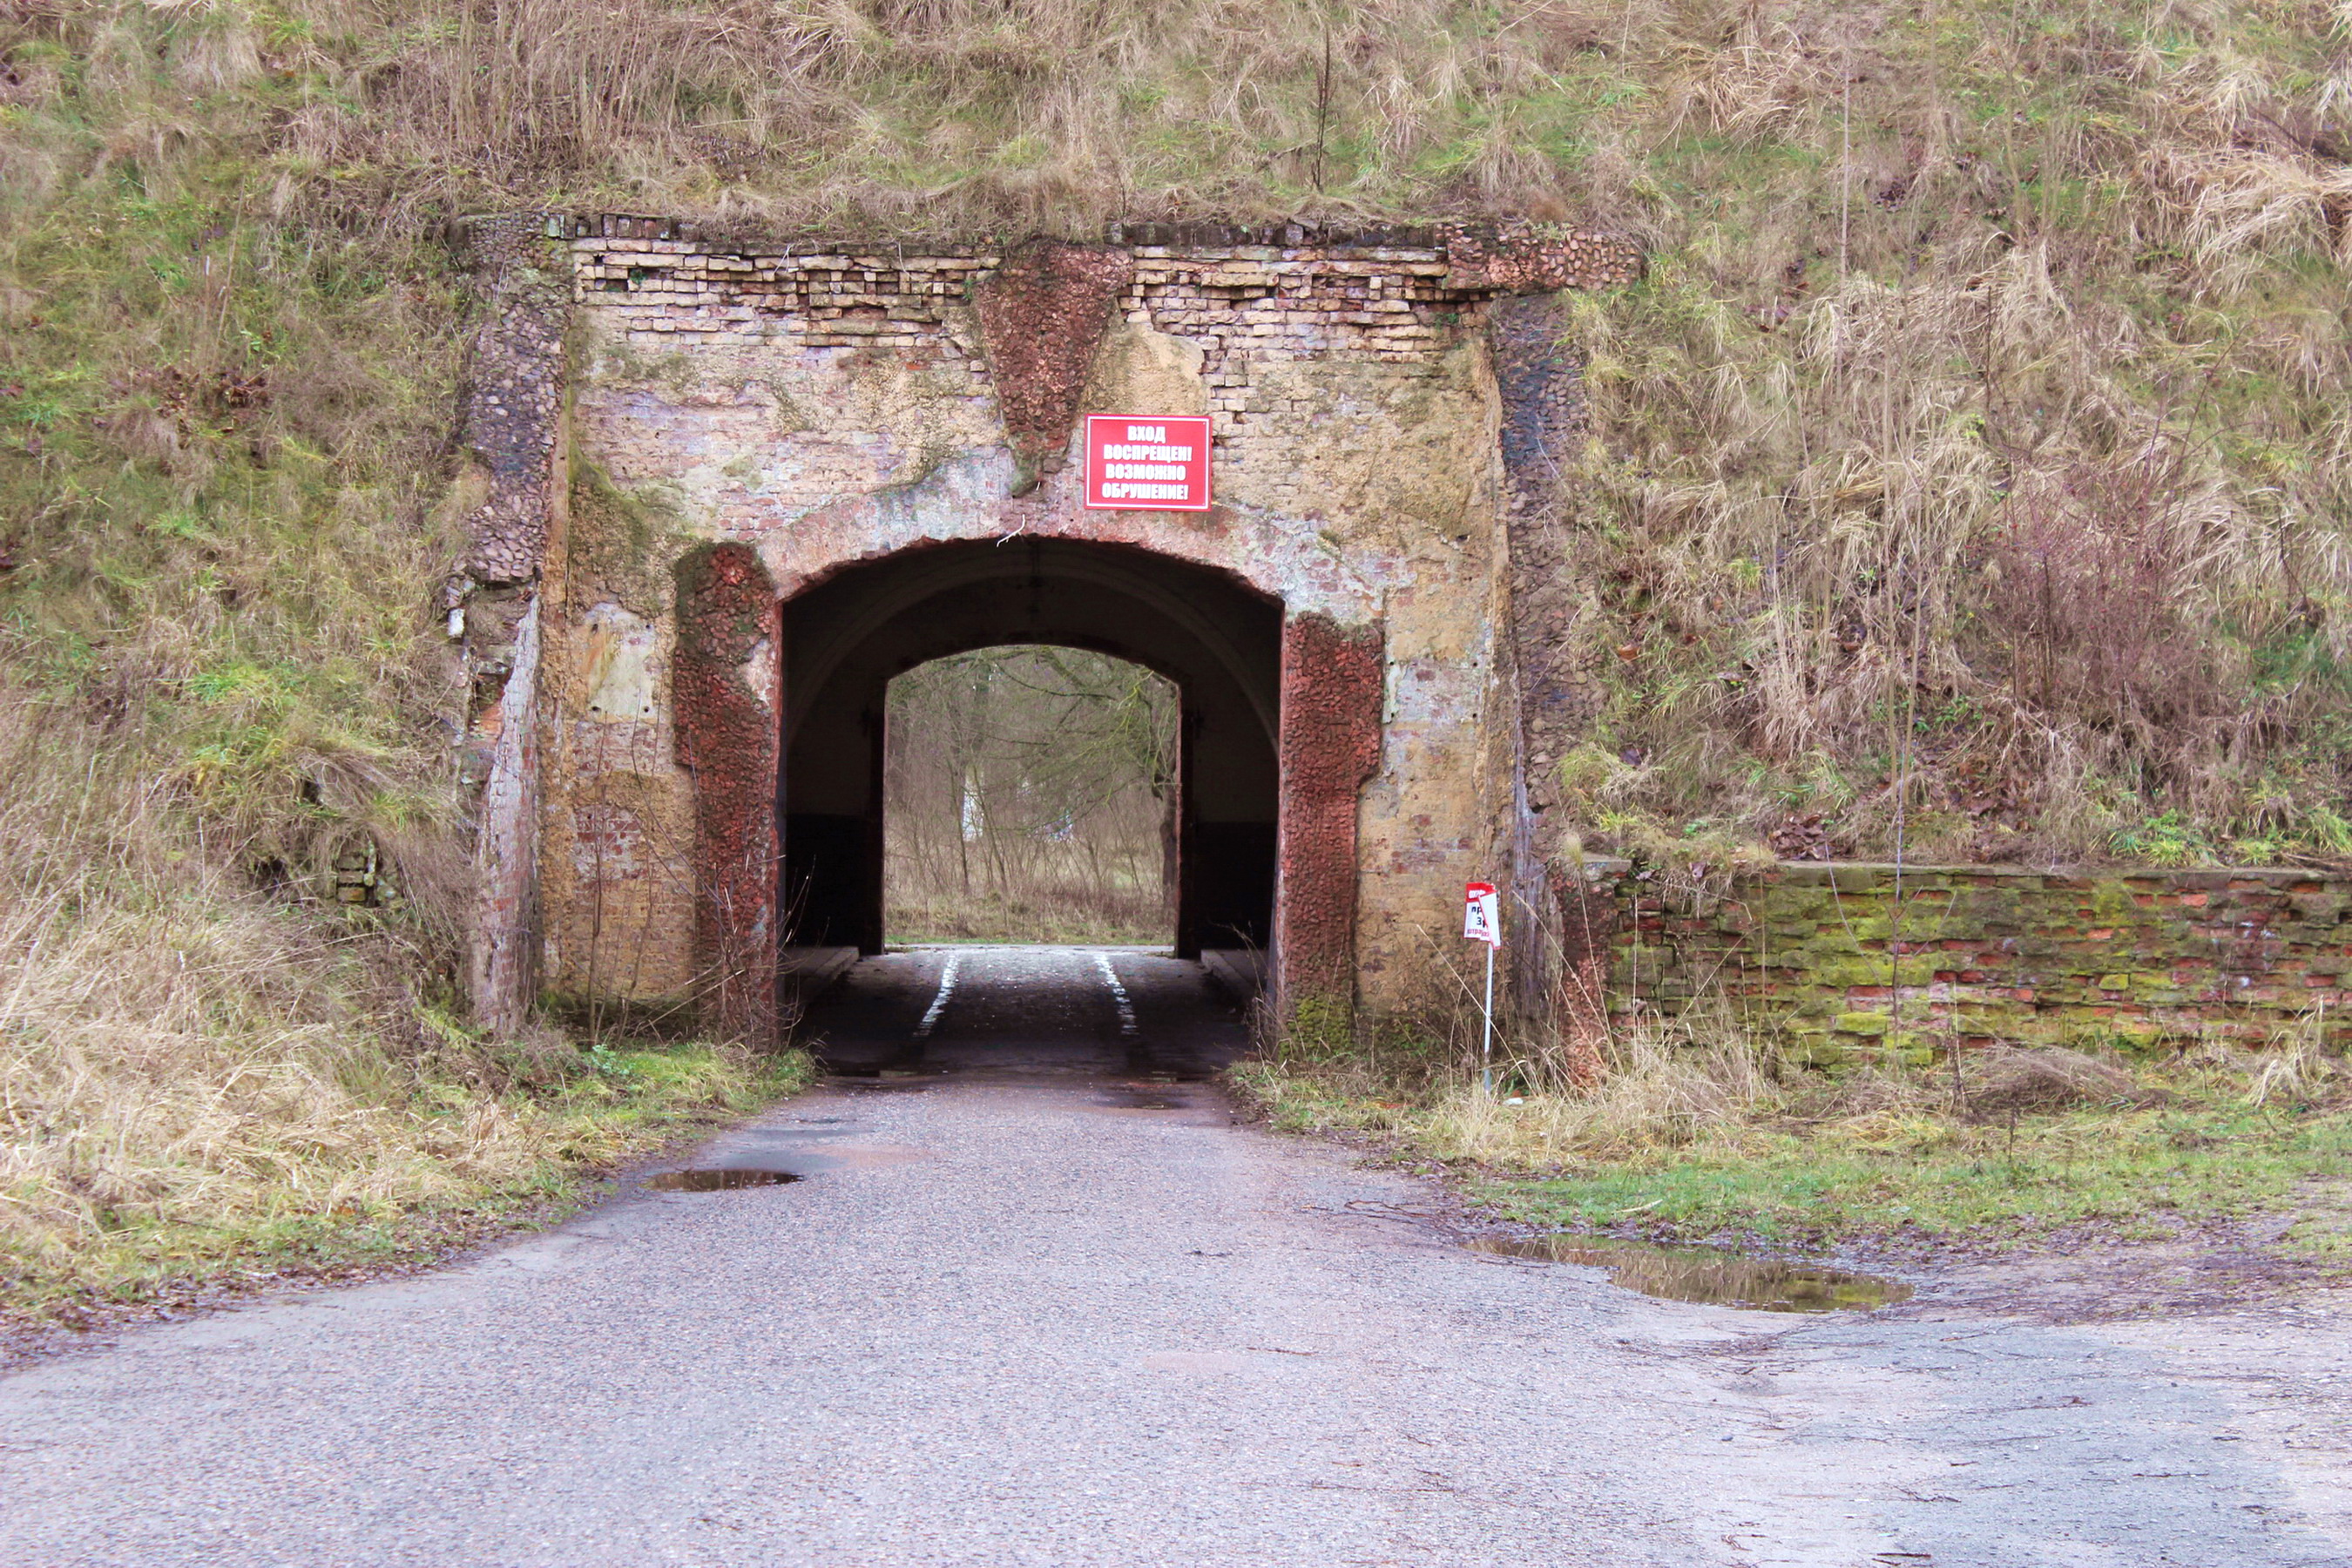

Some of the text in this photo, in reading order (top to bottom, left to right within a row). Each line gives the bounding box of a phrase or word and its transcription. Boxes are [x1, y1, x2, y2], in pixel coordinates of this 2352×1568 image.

[1128, 426, 1166, 443] ВХОД
[1104, 444, 1193, 463] ВОСПРЕЩЕН!
[1105, 463, 1186, 481] ВОЗМОЖНО
[1102, 483, 1189, 500] ОБРУШЕНИЕ!
